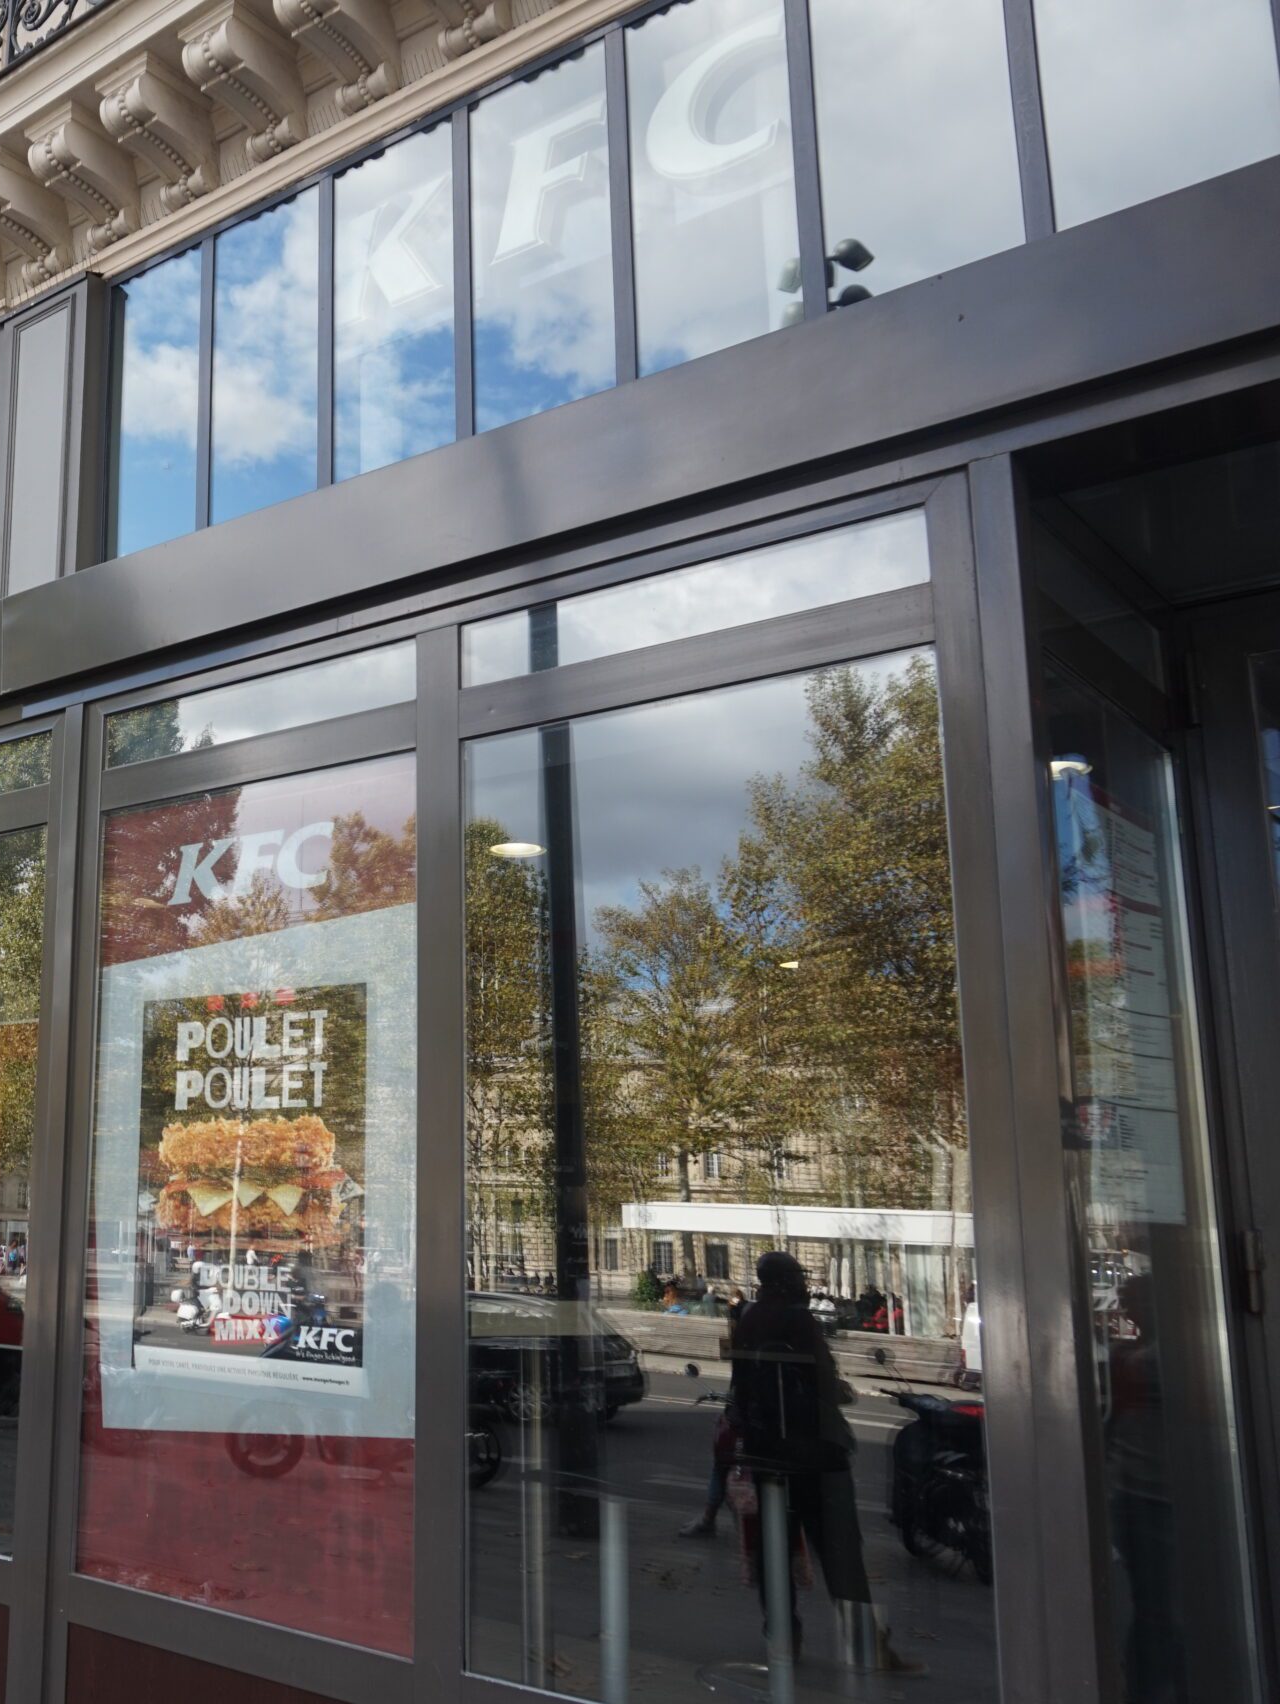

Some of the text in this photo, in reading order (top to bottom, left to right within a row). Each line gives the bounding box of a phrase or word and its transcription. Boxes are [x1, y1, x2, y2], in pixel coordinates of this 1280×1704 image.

[168, 821, 335, 906] KFC
[176, 1009, 328, 1062] POULET
[175, 1062, 328, 1110] POULET
[200, 1264, 292, 1292] DOUBLE
[222, 1291, 292, 1318] DOWN
[297, 1325, 355, 1353] KFC
